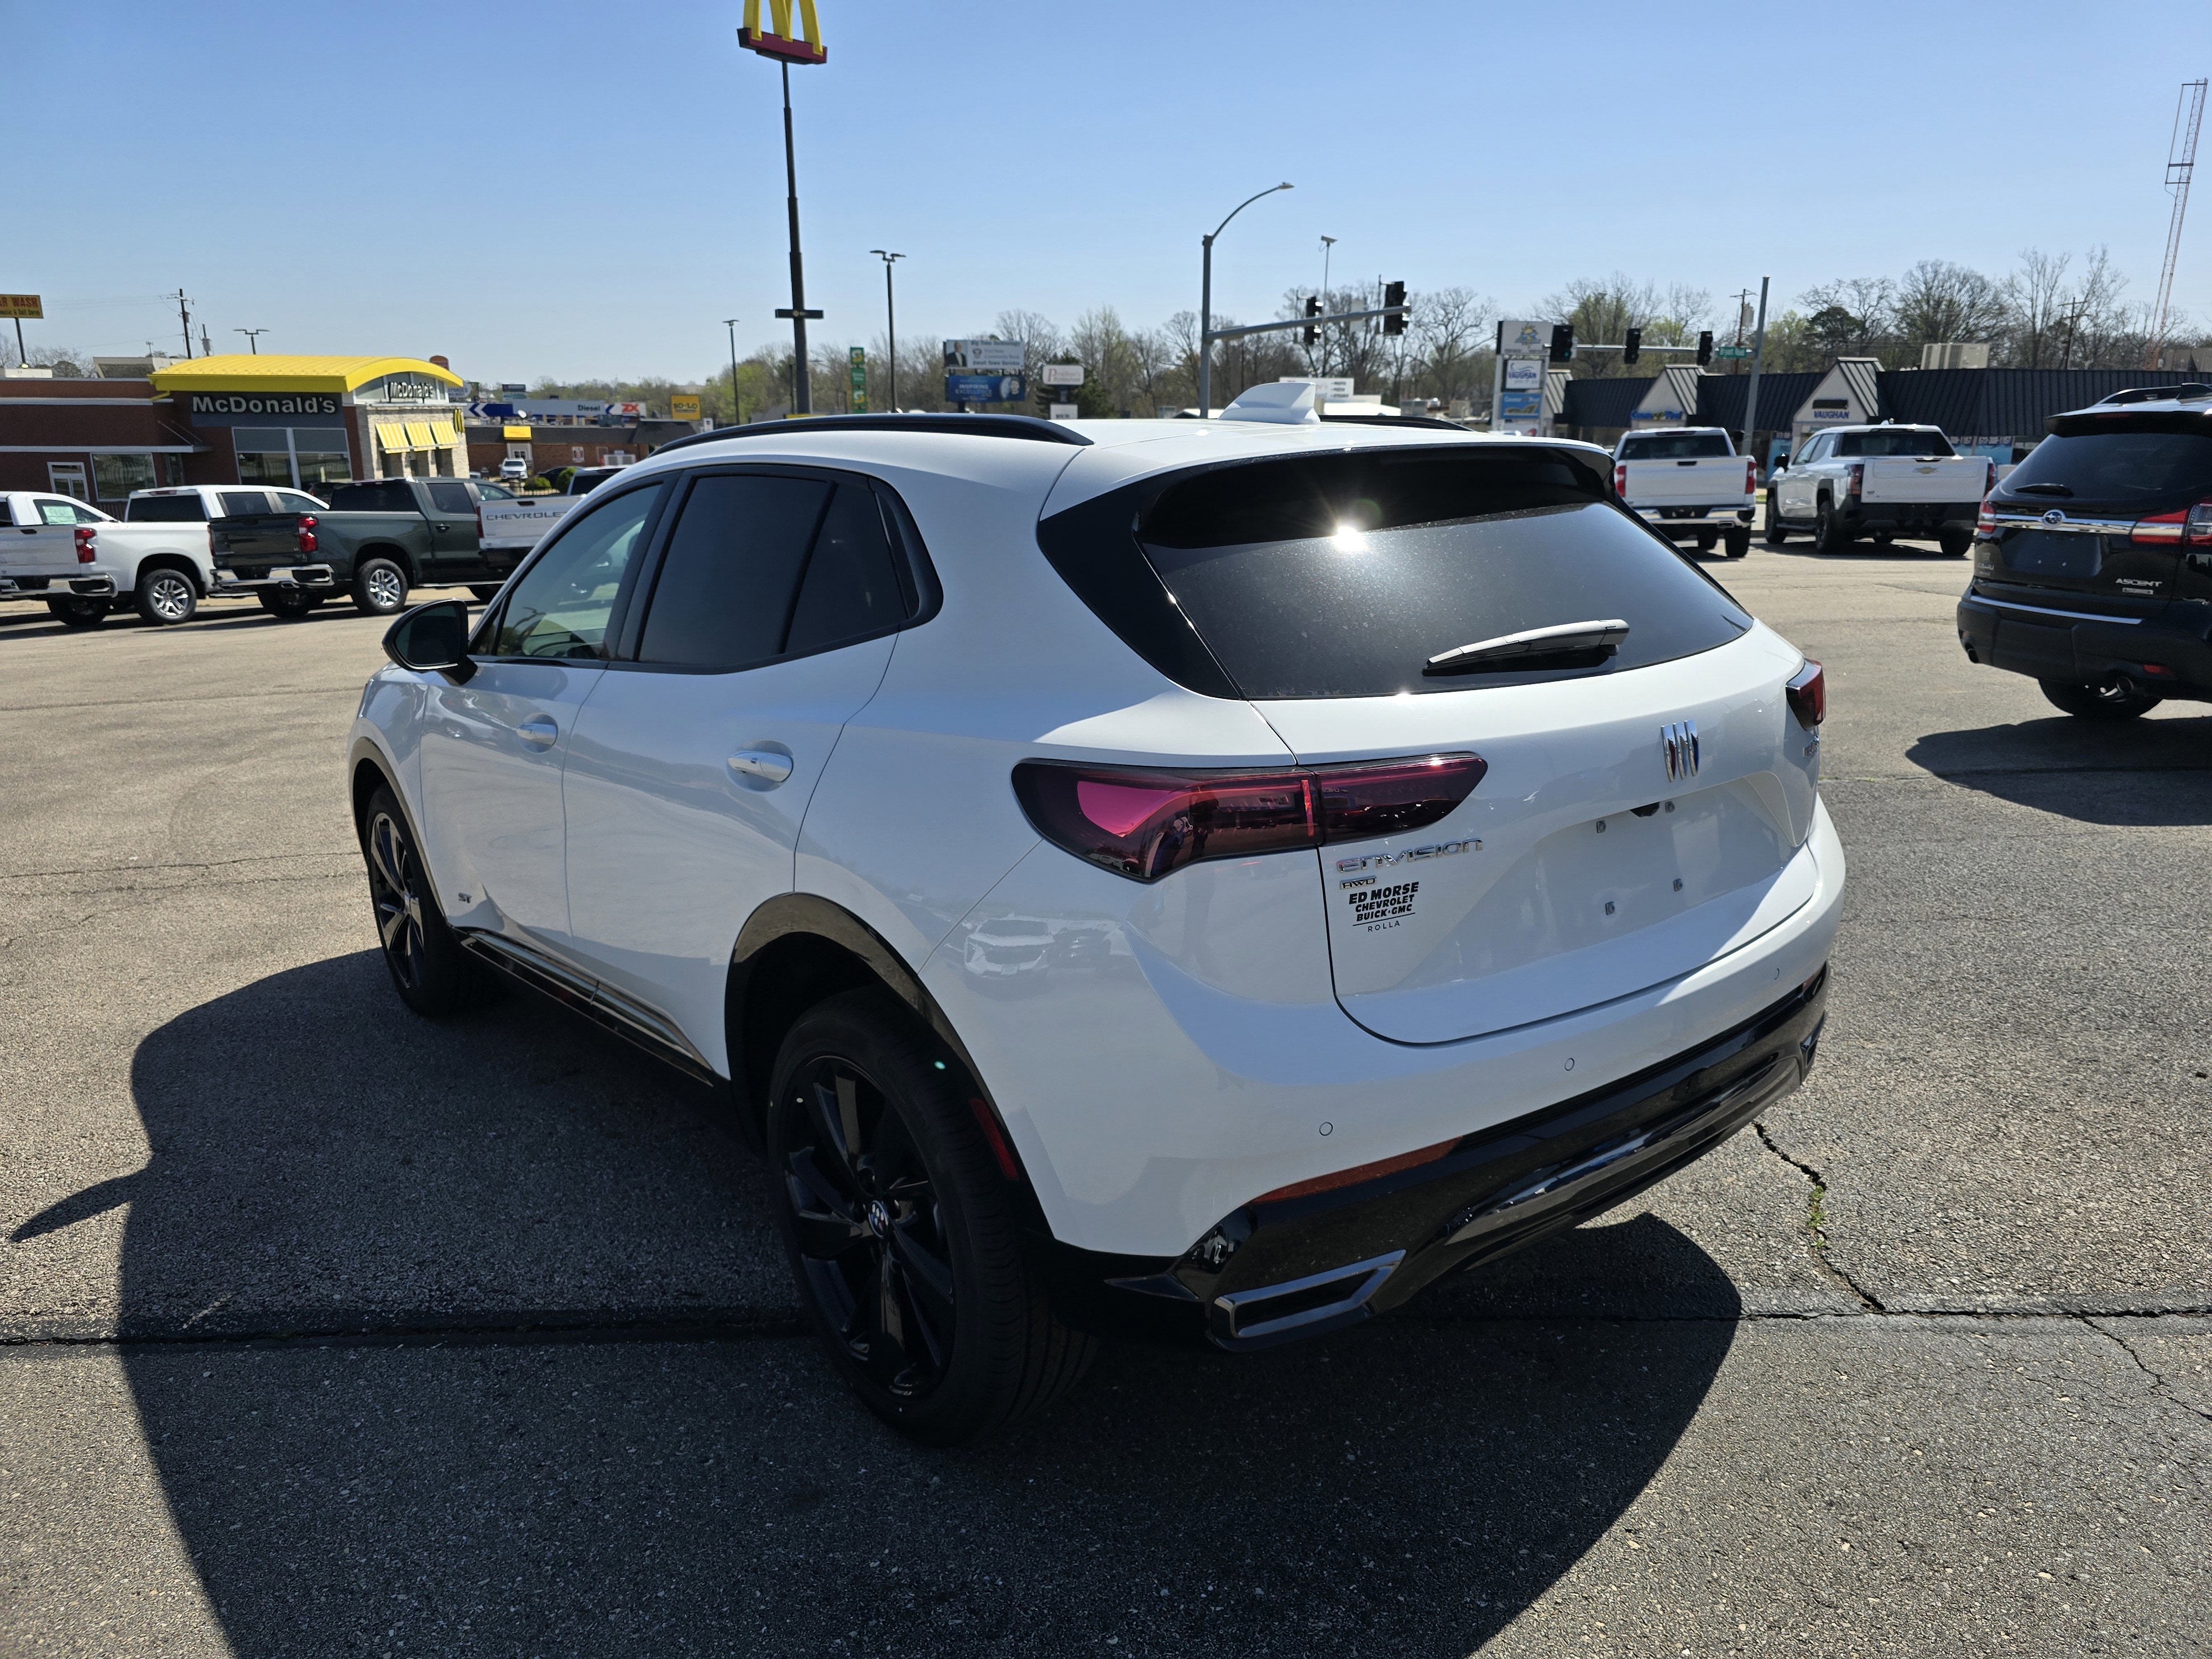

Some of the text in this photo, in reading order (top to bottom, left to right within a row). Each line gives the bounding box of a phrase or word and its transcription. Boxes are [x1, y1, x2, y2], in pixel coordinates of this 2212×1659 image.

[11, 297, 39, 307] WASH
[192, 396, 336, 414] McDonald's
[1813, 410, 1849, 419] VAUGHAN
[486, 512, 567, 521] CHEVROLE
[2115, 578, 2163, 587] ASCENT
[1342, 877, 1377, 889] AWD
[1349, 881, 1419, 905] ED MORSE
[1355, 894, 1415, 912] CHEVROLET
[1368, 920, 1400, 932] ROLLA
